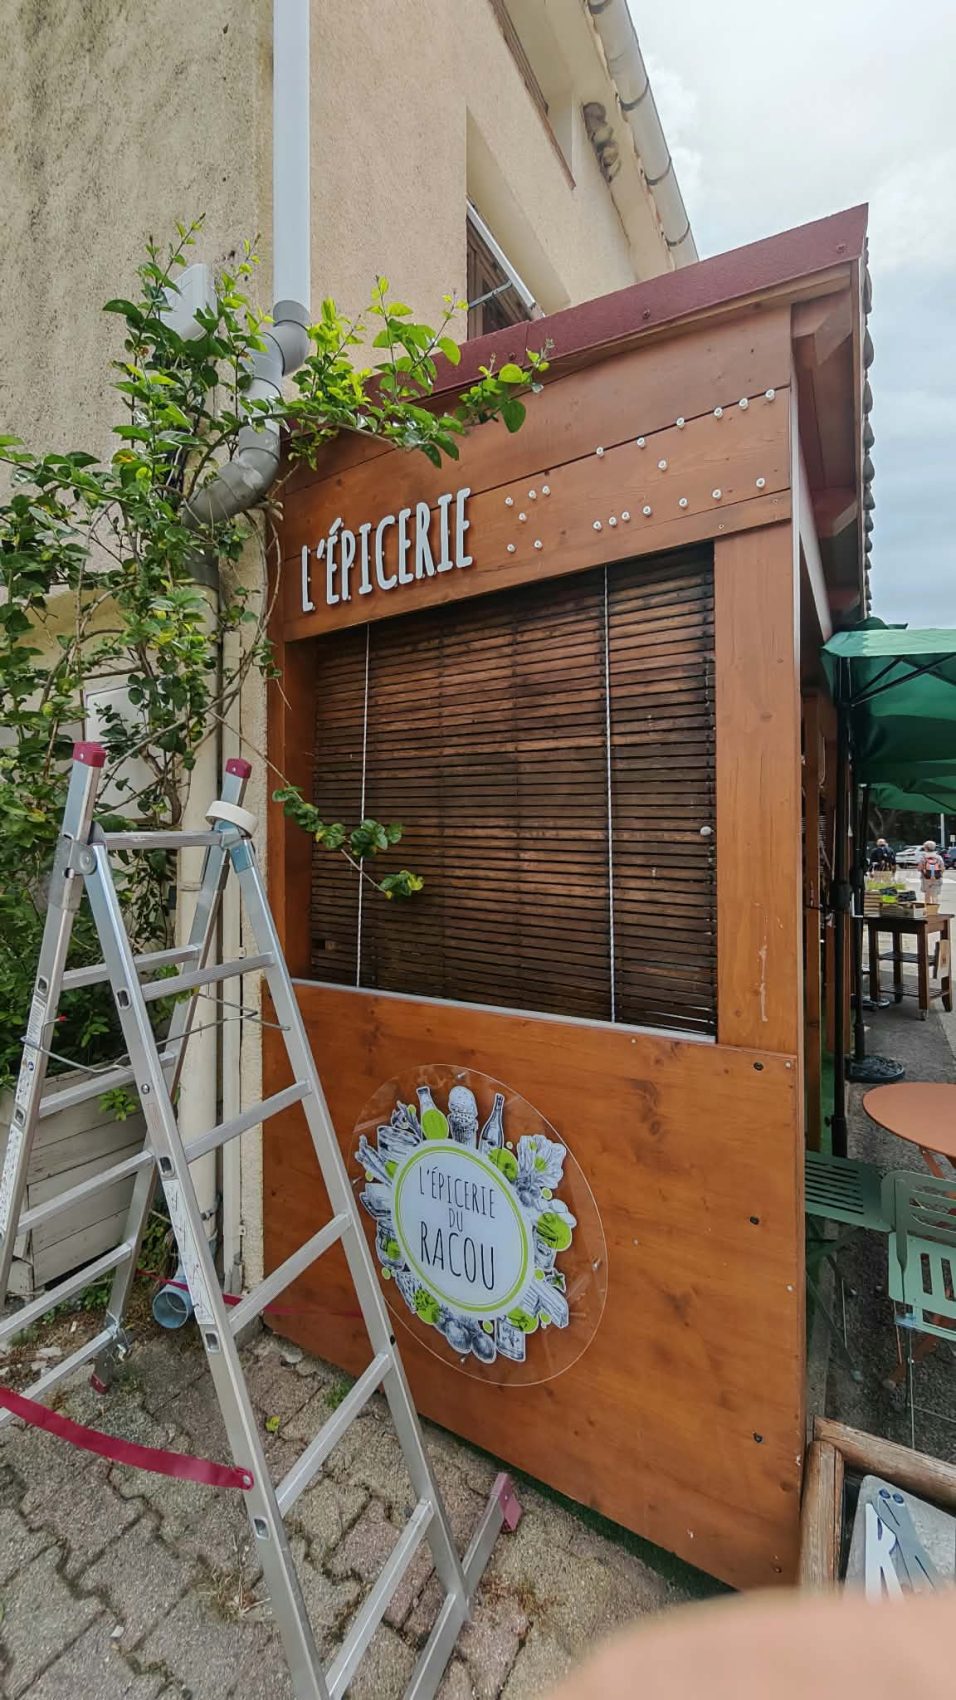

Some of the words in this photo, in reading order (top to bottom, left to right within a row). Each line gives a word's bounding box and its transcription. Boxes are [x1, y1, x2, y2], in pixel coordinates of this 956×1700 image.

[301, 487, 473, 612] L'ÉPICERIE
[419, 1165, 495, 1219] L'ÉPICERIE
[449, 1208, 463, 1232] DU
[420, 1220, 495, 1290] RACOU
